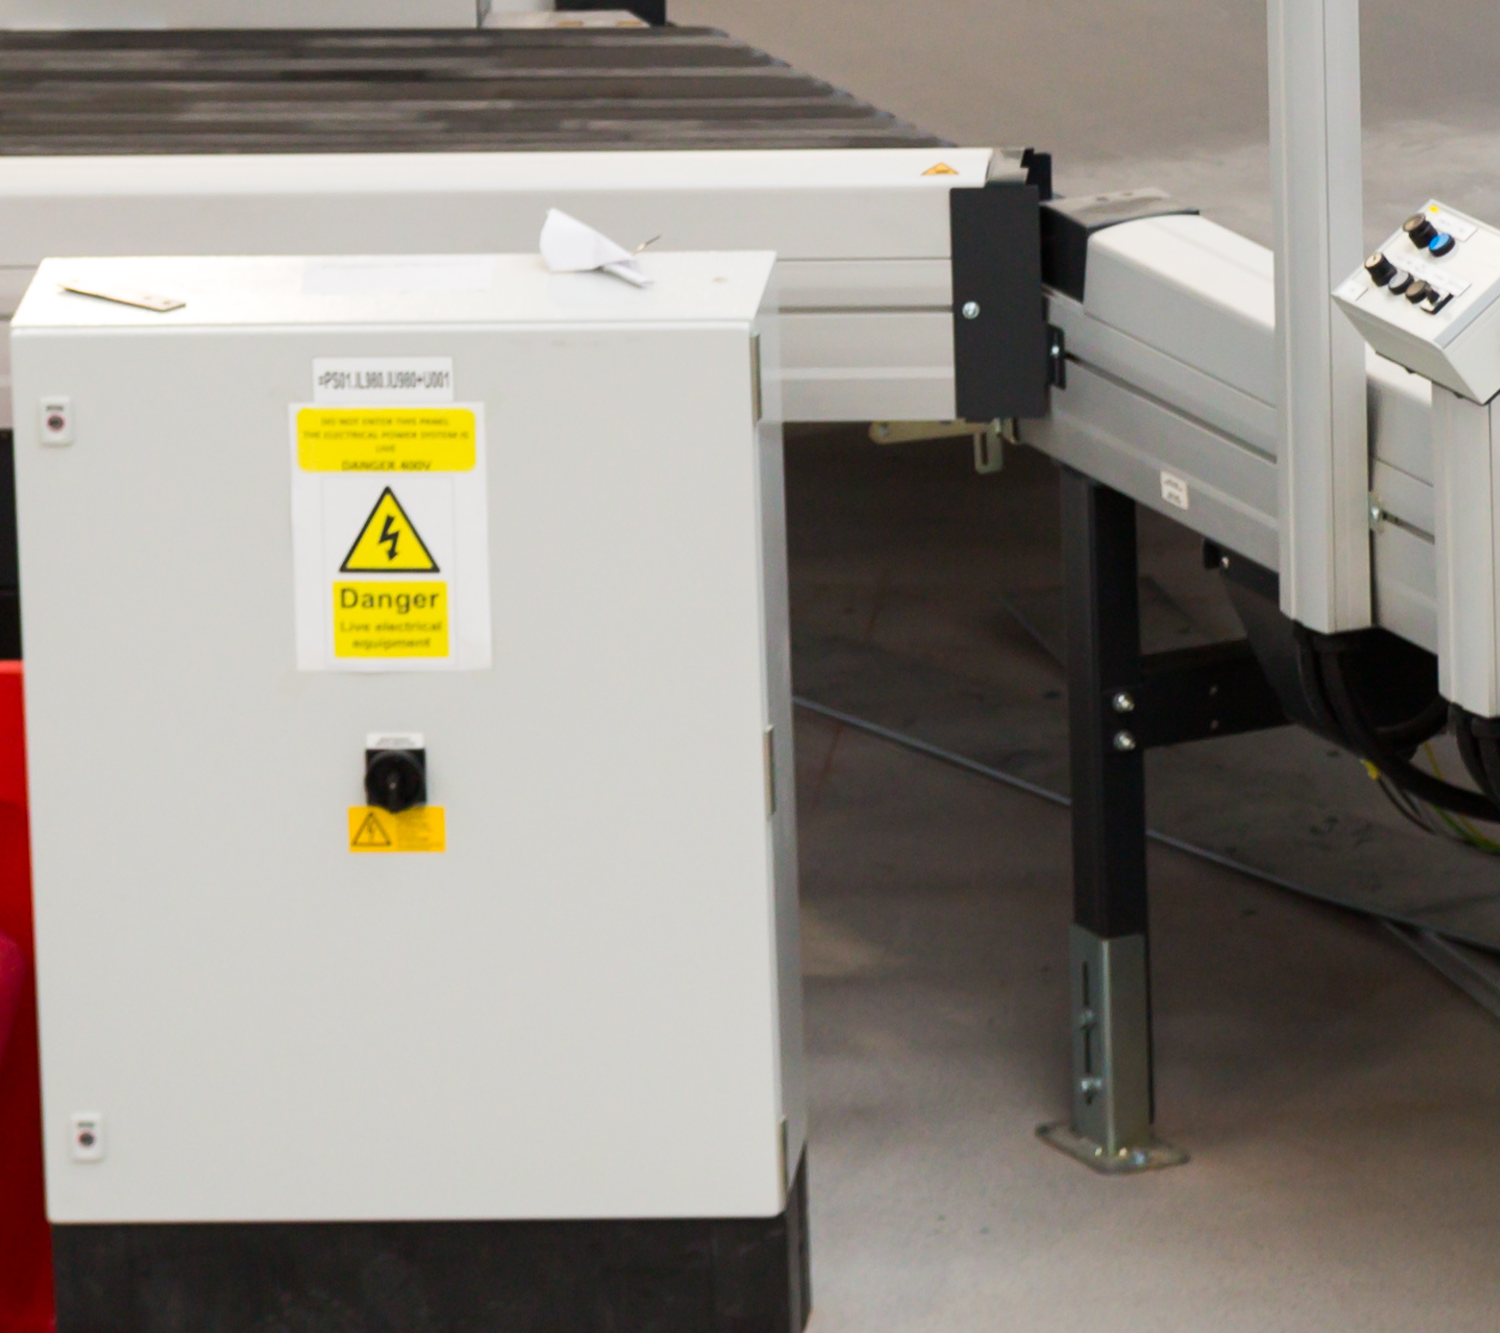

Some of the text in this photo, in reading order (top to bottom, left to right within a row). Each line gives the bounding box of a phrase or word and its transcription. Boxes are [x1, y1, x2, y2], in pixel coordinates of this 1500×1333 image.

[341, 460, 395, 471] DANGER
[340, 587, 439, 614] Danger
[340, 620, 442, 632] Live electrical
[352, 638, 431, 651] equipment
